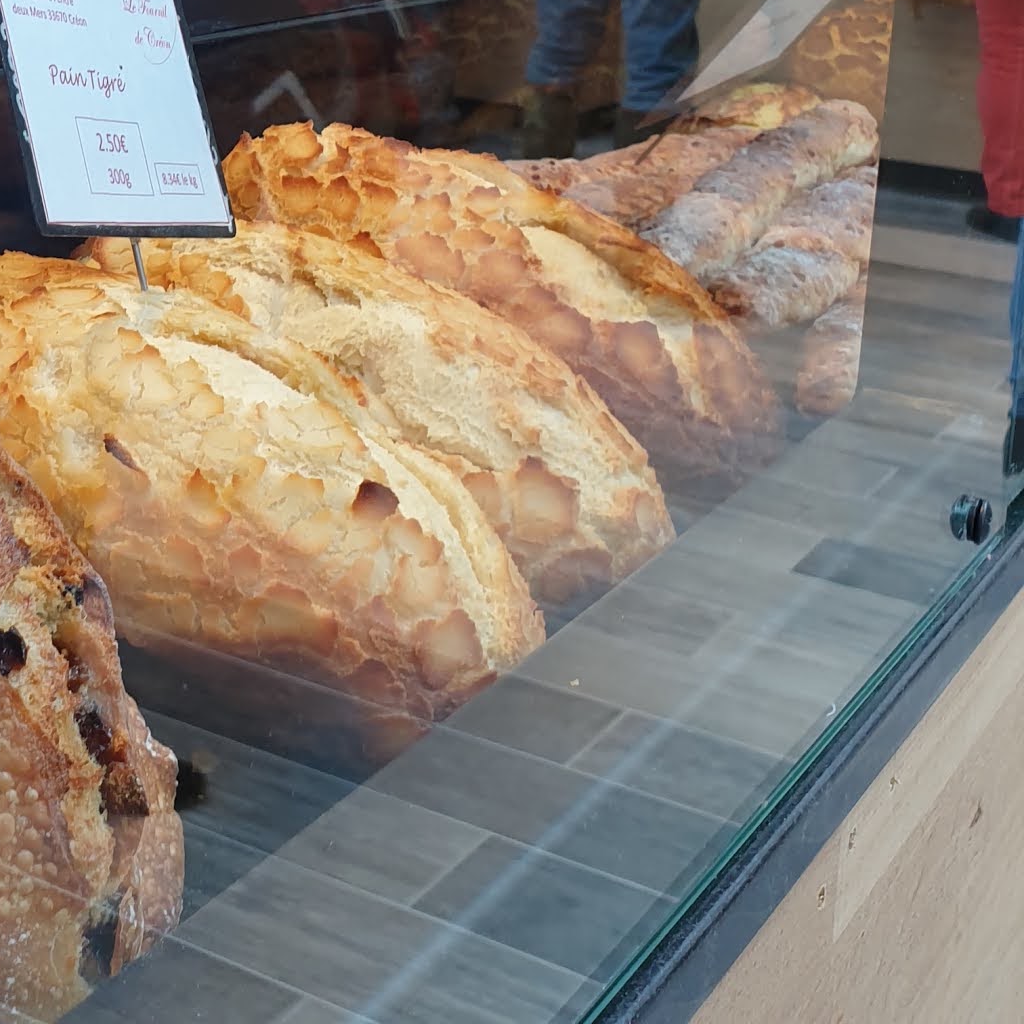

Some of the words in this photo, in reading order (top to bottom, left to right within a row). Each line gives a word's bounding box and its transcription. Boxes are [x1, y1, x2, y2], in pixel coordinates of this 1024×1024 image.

[12, 3, 29, 17] deux
[29, 6, 48, 20] Mers
[134, 30, 144, 45] de
[48, 64, 87, 87] Pain
[87, 69, 126, 99] Tigré
[95, 132, 129, 154] 2.50€
[107, 168, 132, 189] 300g
